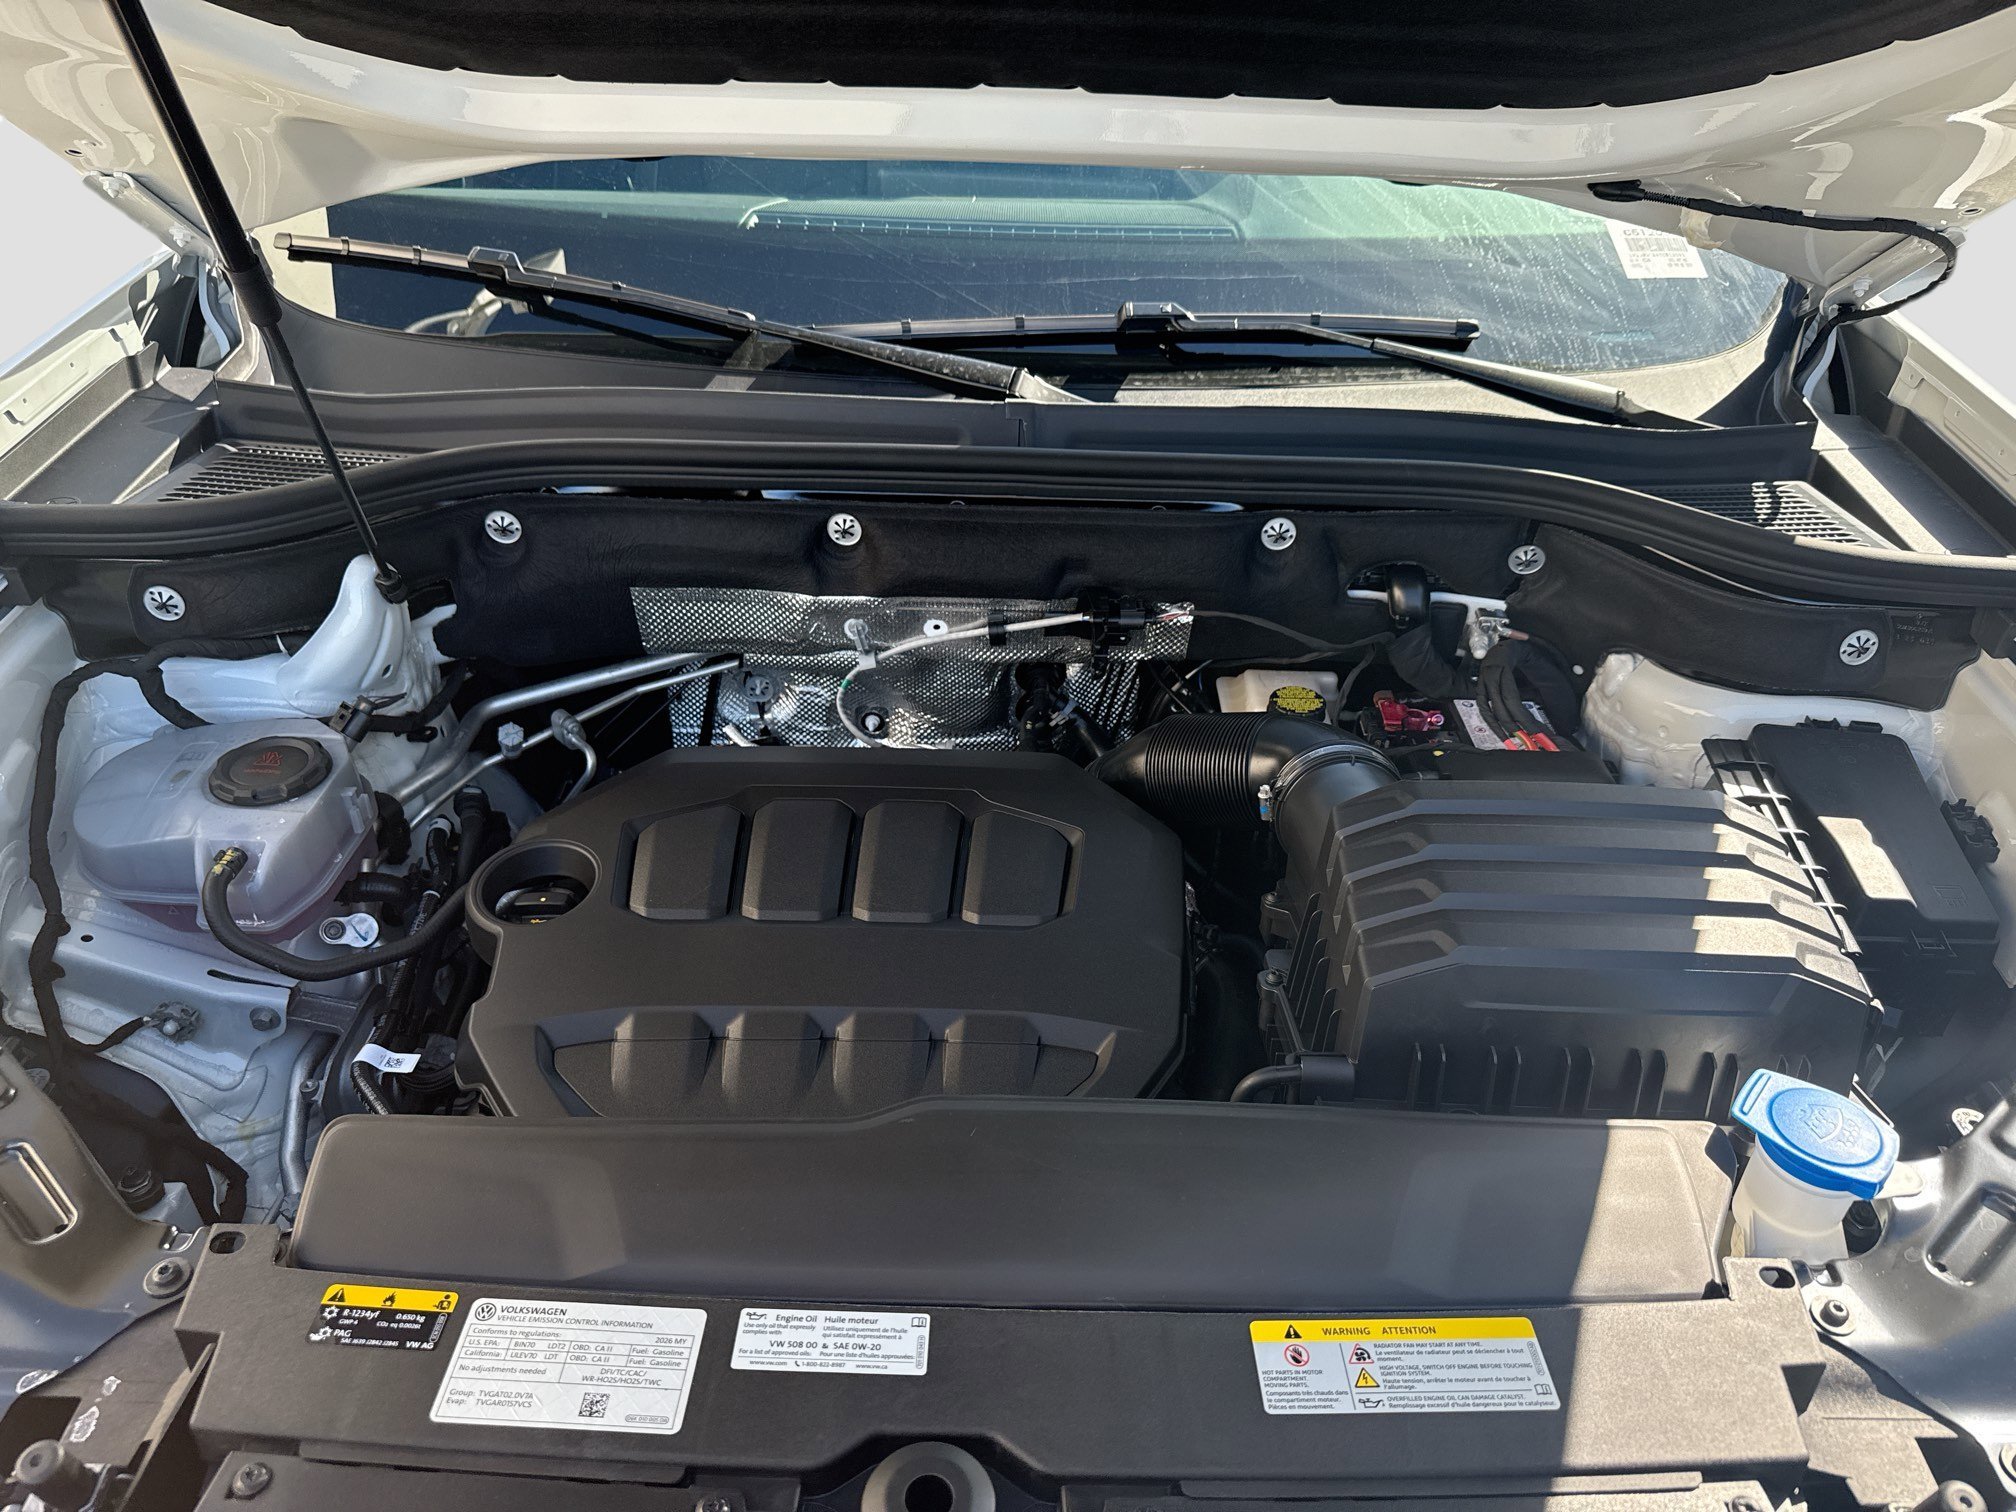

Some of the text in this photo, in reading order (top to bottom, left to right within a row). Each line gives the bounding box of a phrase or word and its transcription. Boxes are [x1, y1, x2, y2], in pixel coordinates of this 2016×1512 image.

[500, 1306, 568, 1316] VOLKSWAGEN
[416, 1314, 426, 1322] kg
[776, 1314, 804, 1324] Engine
[601, 1320, 654, 1329] INFORMATION
[333, 1329, 352, 1337] PAG
[518, 1329, 562, 1338] regulations:
[1322, 1326, 1436, 1336] WARNING ATTENTION
[851, 1343, 881, 1351] 0W-20
[652, 1348, 684, 1356] Gasoline
[649, 1358, 681, 1367] Gasoline
[471, 1365, 517, 1374] adjustments
[449, 1388, 475, 1397] Group:
